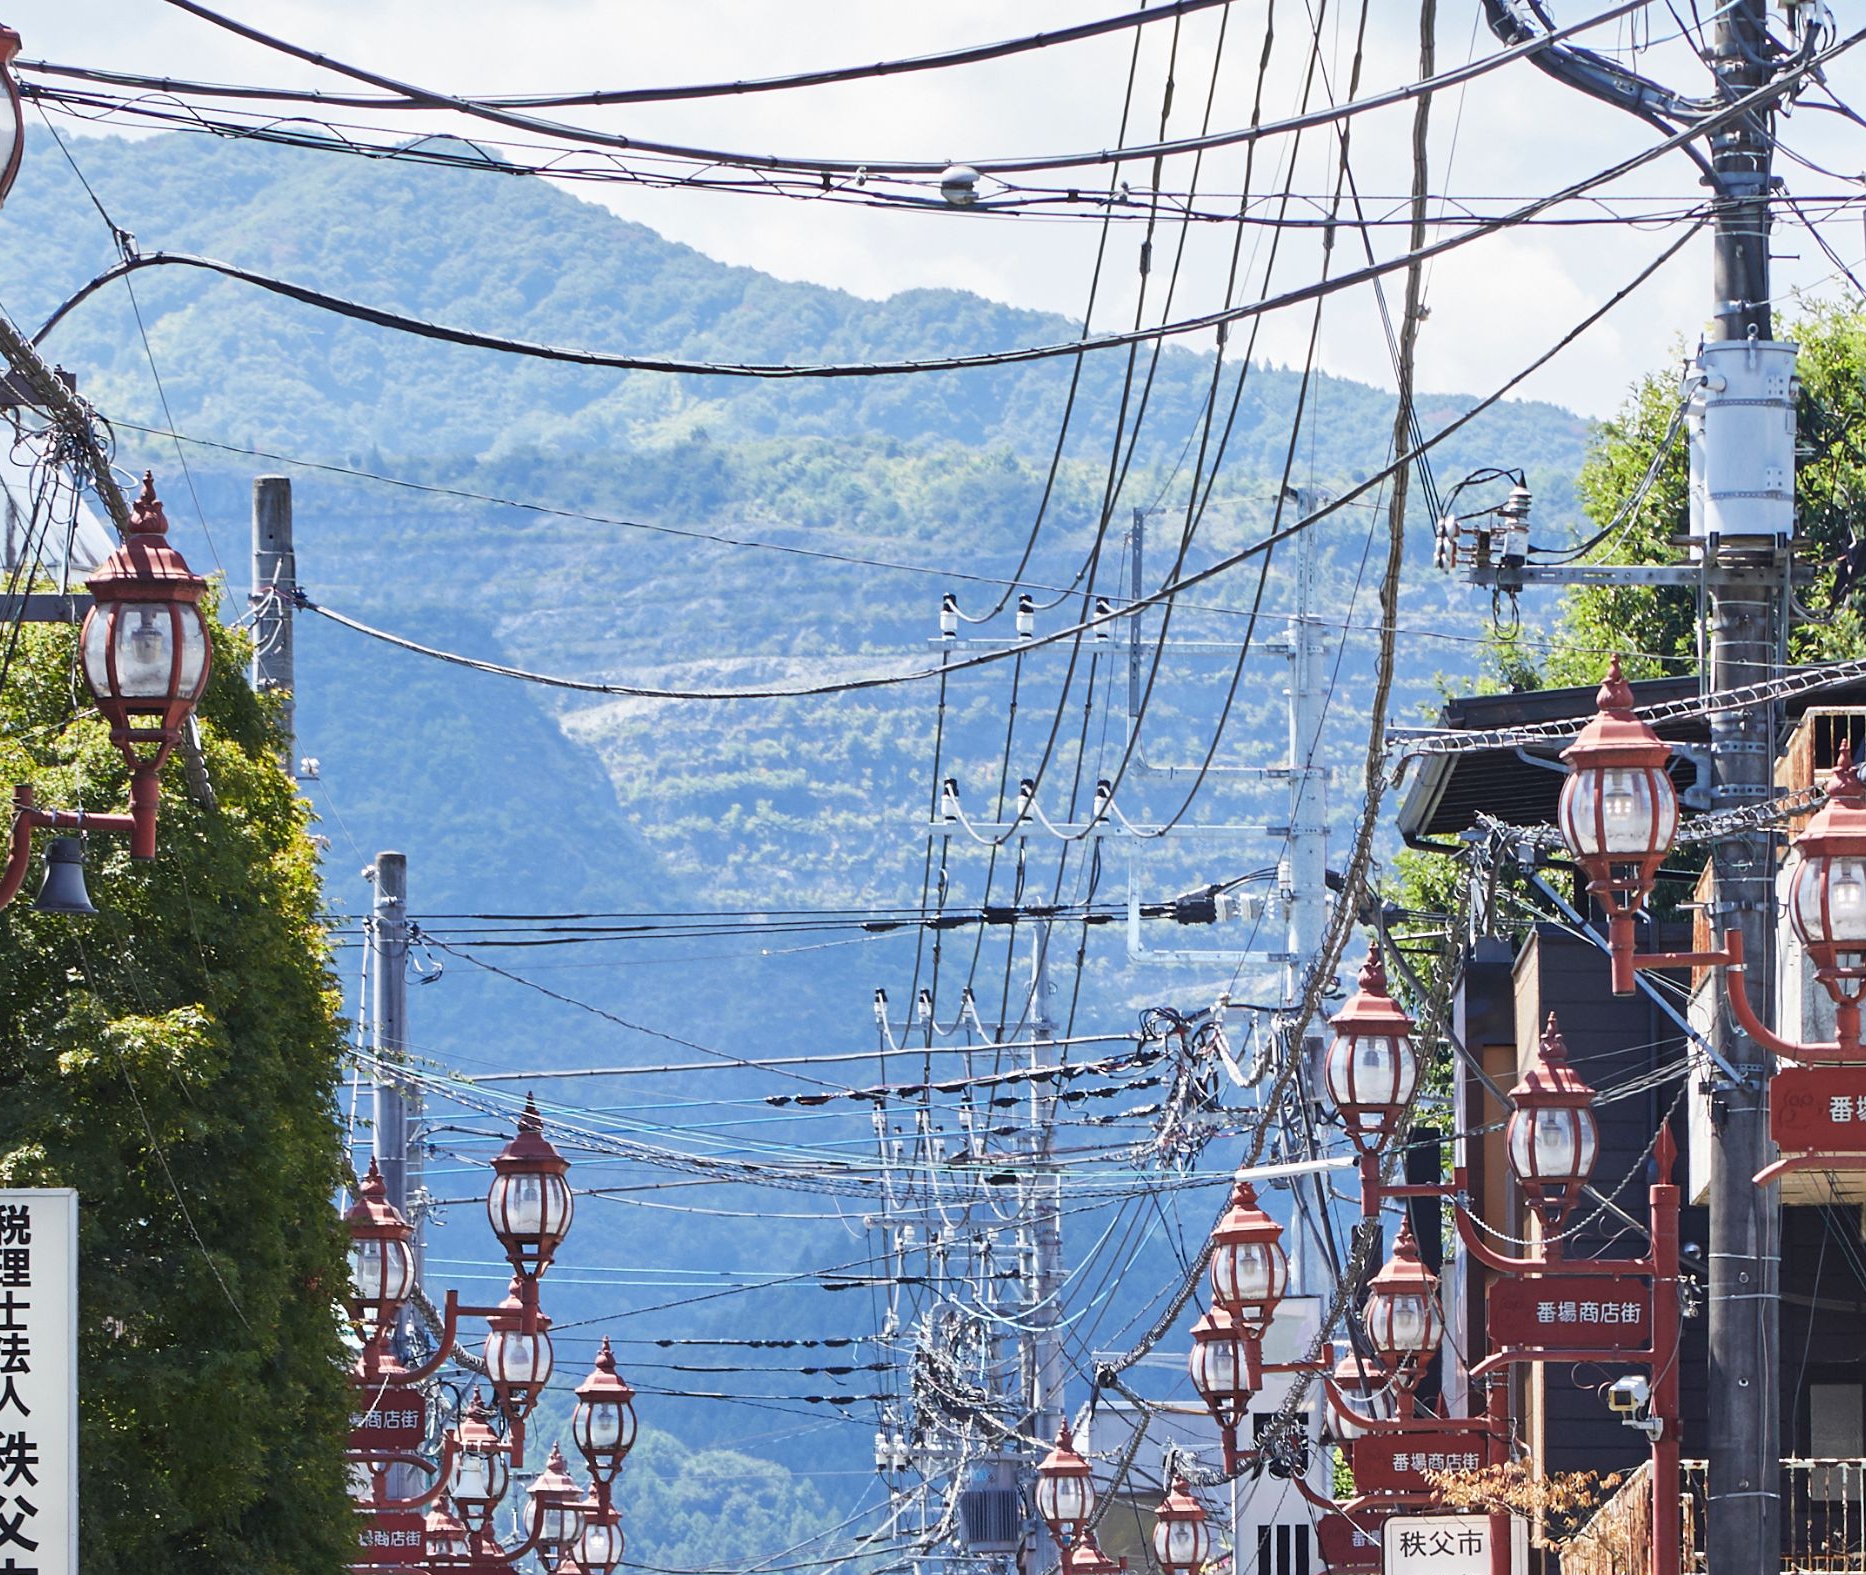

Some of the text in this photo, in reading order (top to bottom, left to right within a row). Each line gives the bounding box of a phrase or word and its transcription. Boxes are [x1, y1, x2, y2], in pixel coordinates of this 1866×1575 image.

[1536, 1301, 1642, 1326] 番場商店街
[1392, 1451, 1480, 1473] 番場商店街
[1400, 1530, 1484, 1557] 秩父市
